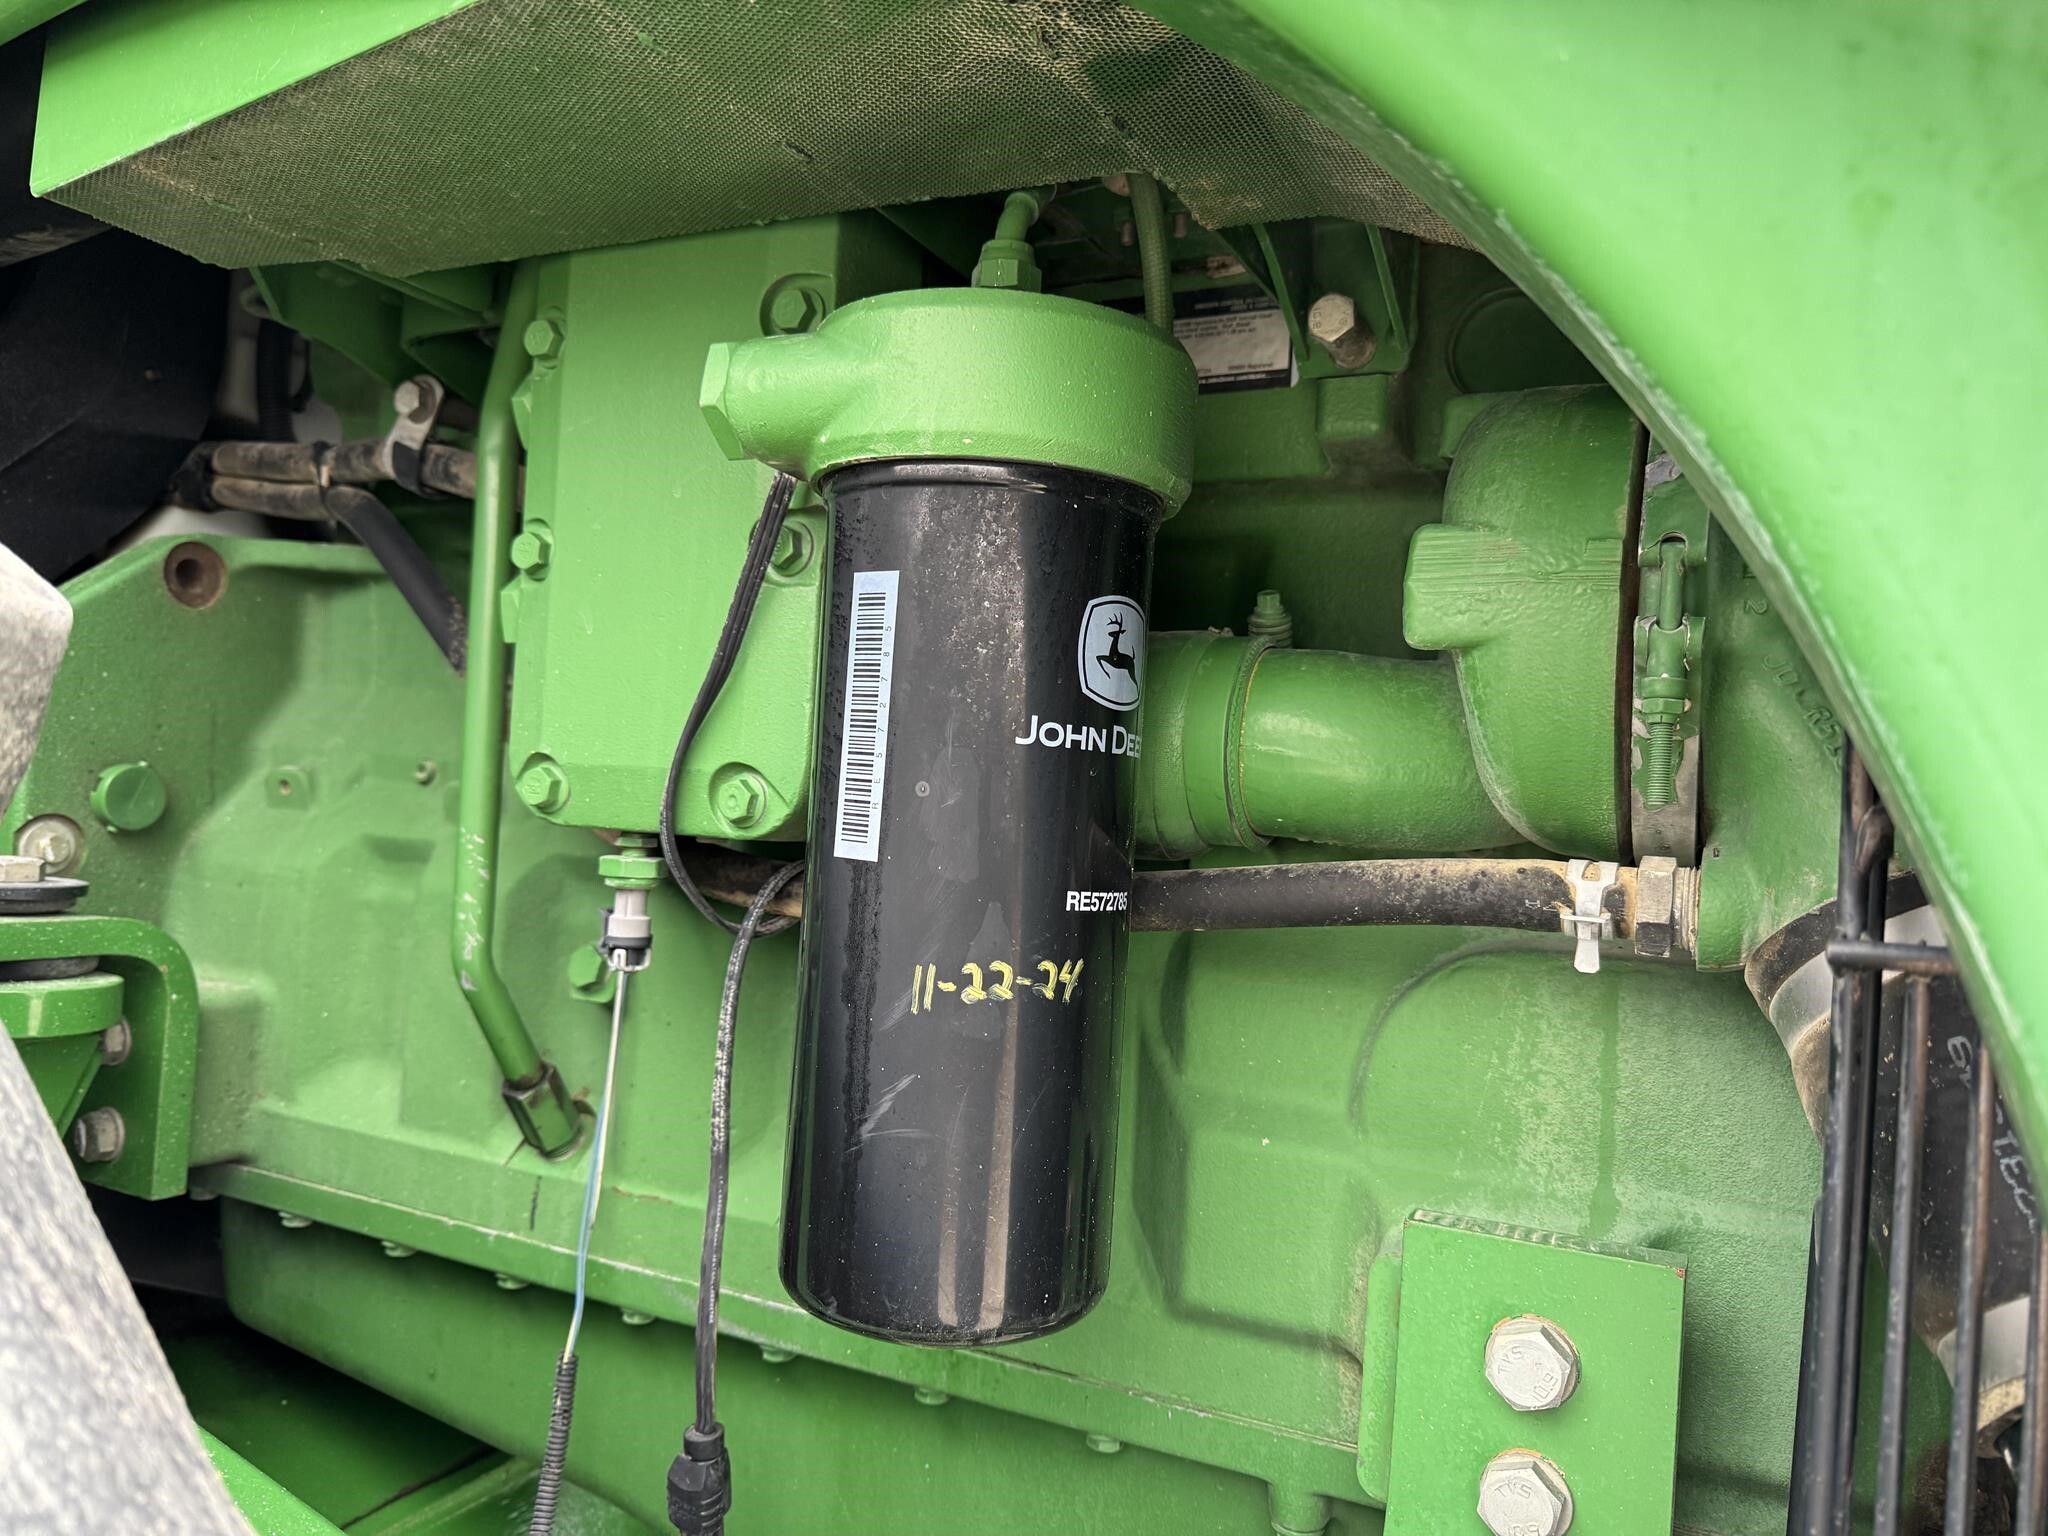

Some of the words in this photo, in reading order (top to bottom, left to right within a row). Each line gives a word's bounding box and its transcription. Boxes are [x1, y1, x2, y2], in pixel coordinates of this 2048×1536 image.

[1015, 715, 1107, 753] JOHN
[1111, 724, 1142, 759] DEE
[1065, 890, 1128, 912] RE572785
[910, 957, 1085, 1015] 11-22-24
